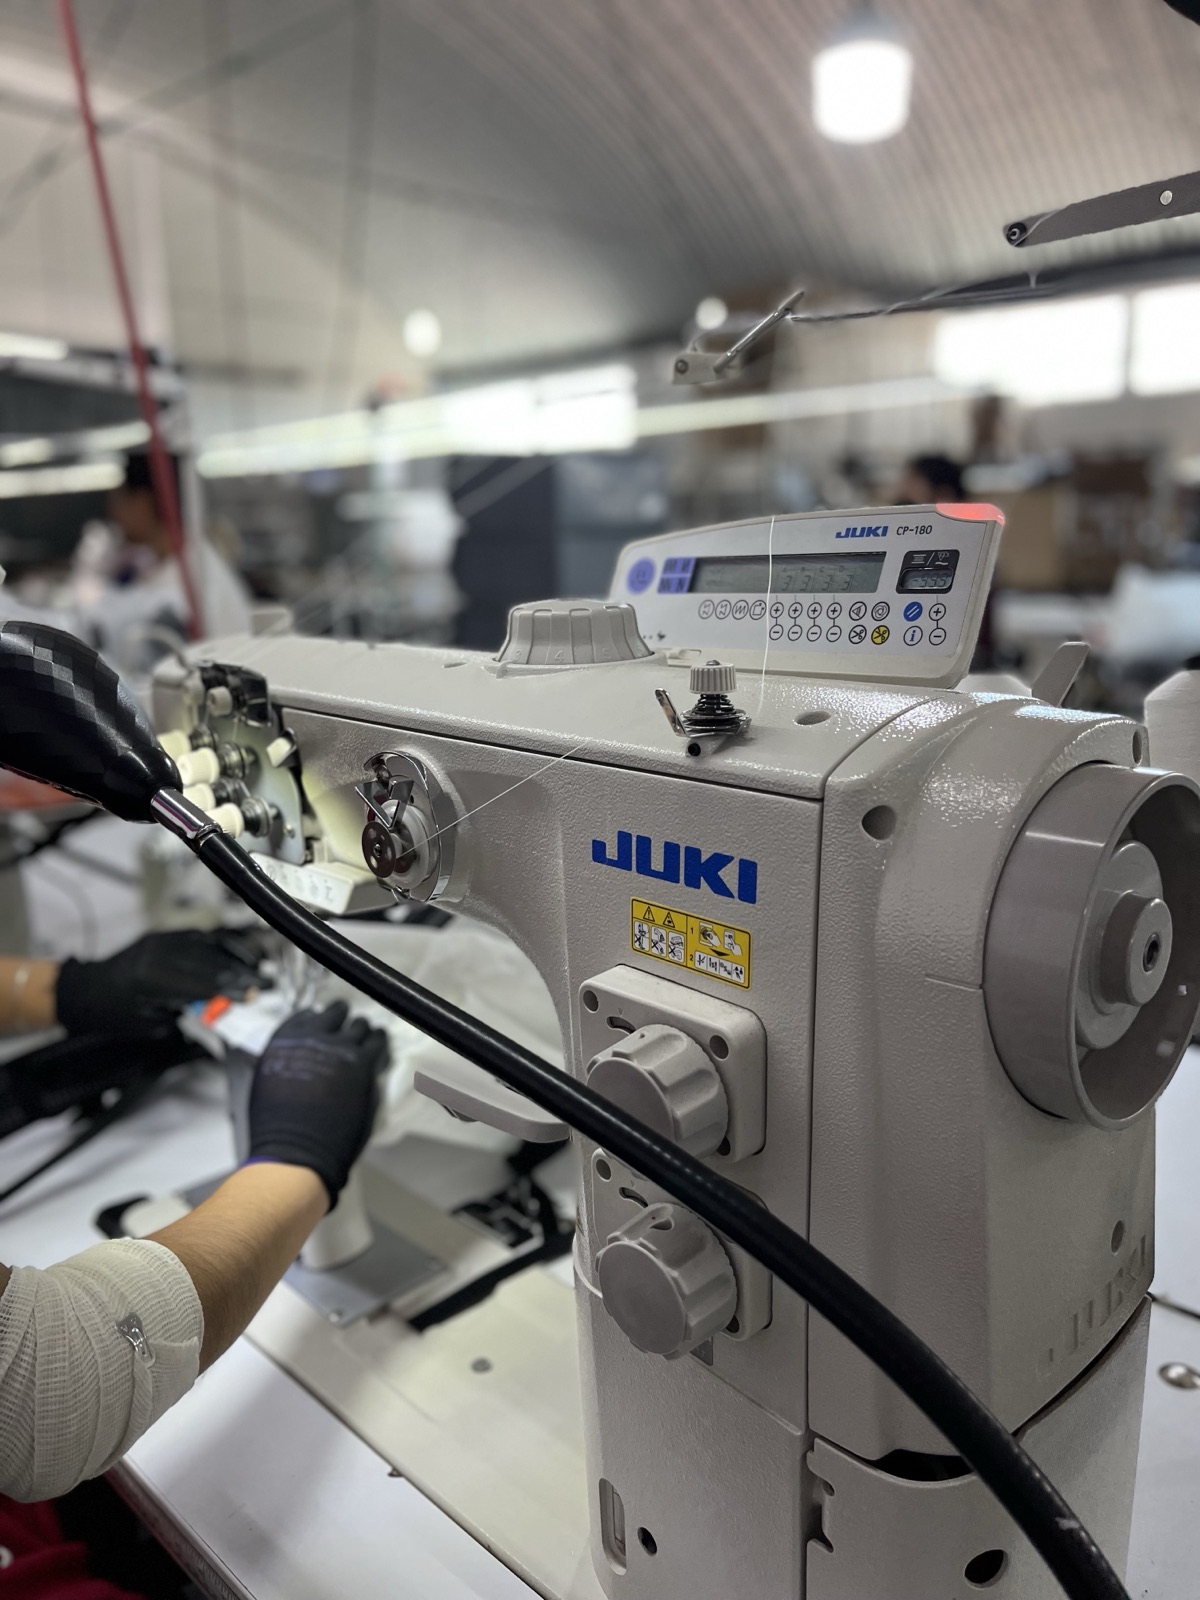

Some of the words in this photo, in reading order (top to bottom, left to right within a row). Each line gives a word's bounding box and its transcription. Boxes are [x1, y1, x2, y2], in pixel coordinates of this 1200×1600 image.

[835, 525, 889, 539] JUKI
[896, 524, 933, 536] CP-180
[554, 650, 565, 662] 4
[592, 830, 758, 905] JUKI
